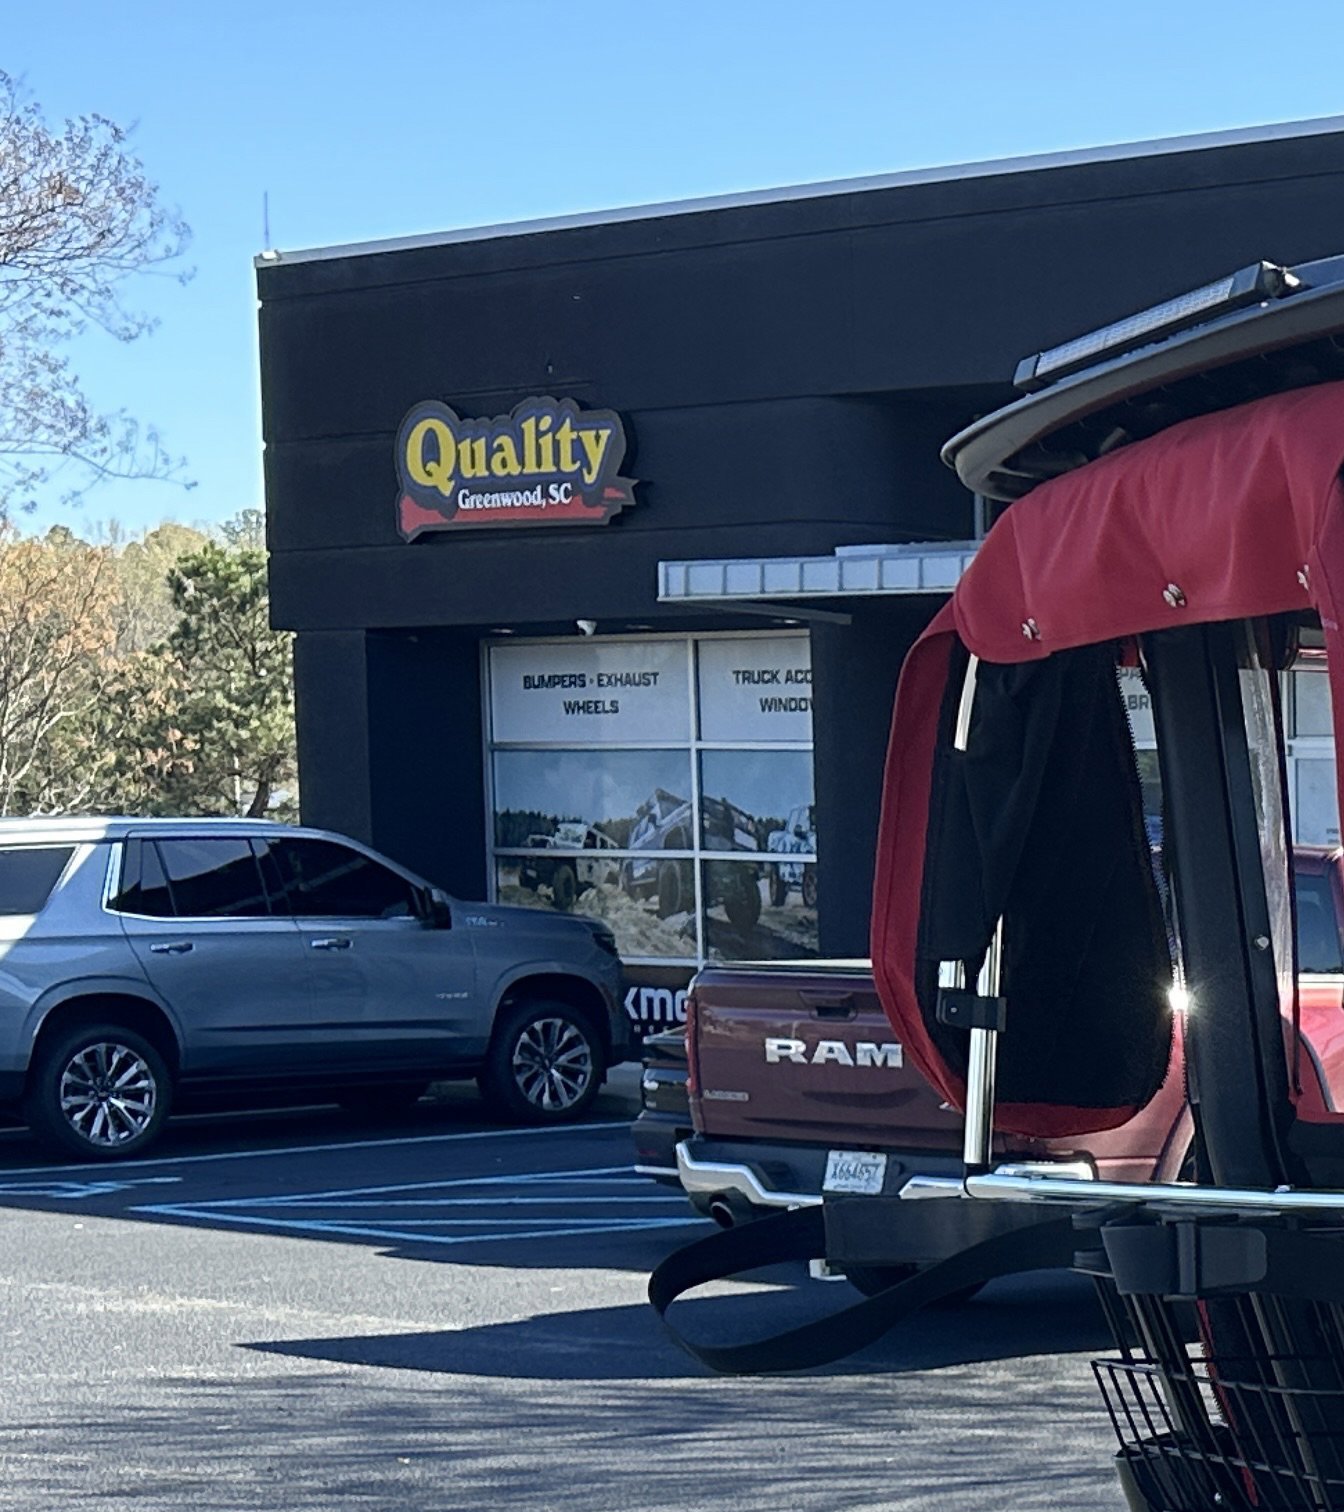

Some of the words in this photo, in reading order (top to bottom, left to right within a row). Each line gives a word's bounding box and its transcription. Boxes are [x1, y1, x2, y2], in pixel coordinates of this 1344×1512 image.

[406, 415, 612, 497] Quality
[458, 486, 546, 510] Greenwood,
[548, 482, 573, 505] SC
[522, 672, 587, 690] BUMPERS
[596, 671, 660, 688] EXHAUST
[732, 669, 780, 685] TRUCK
[563, 699, 620, 715] WHEELS
[765, 1037, 904, 1069] RAM
